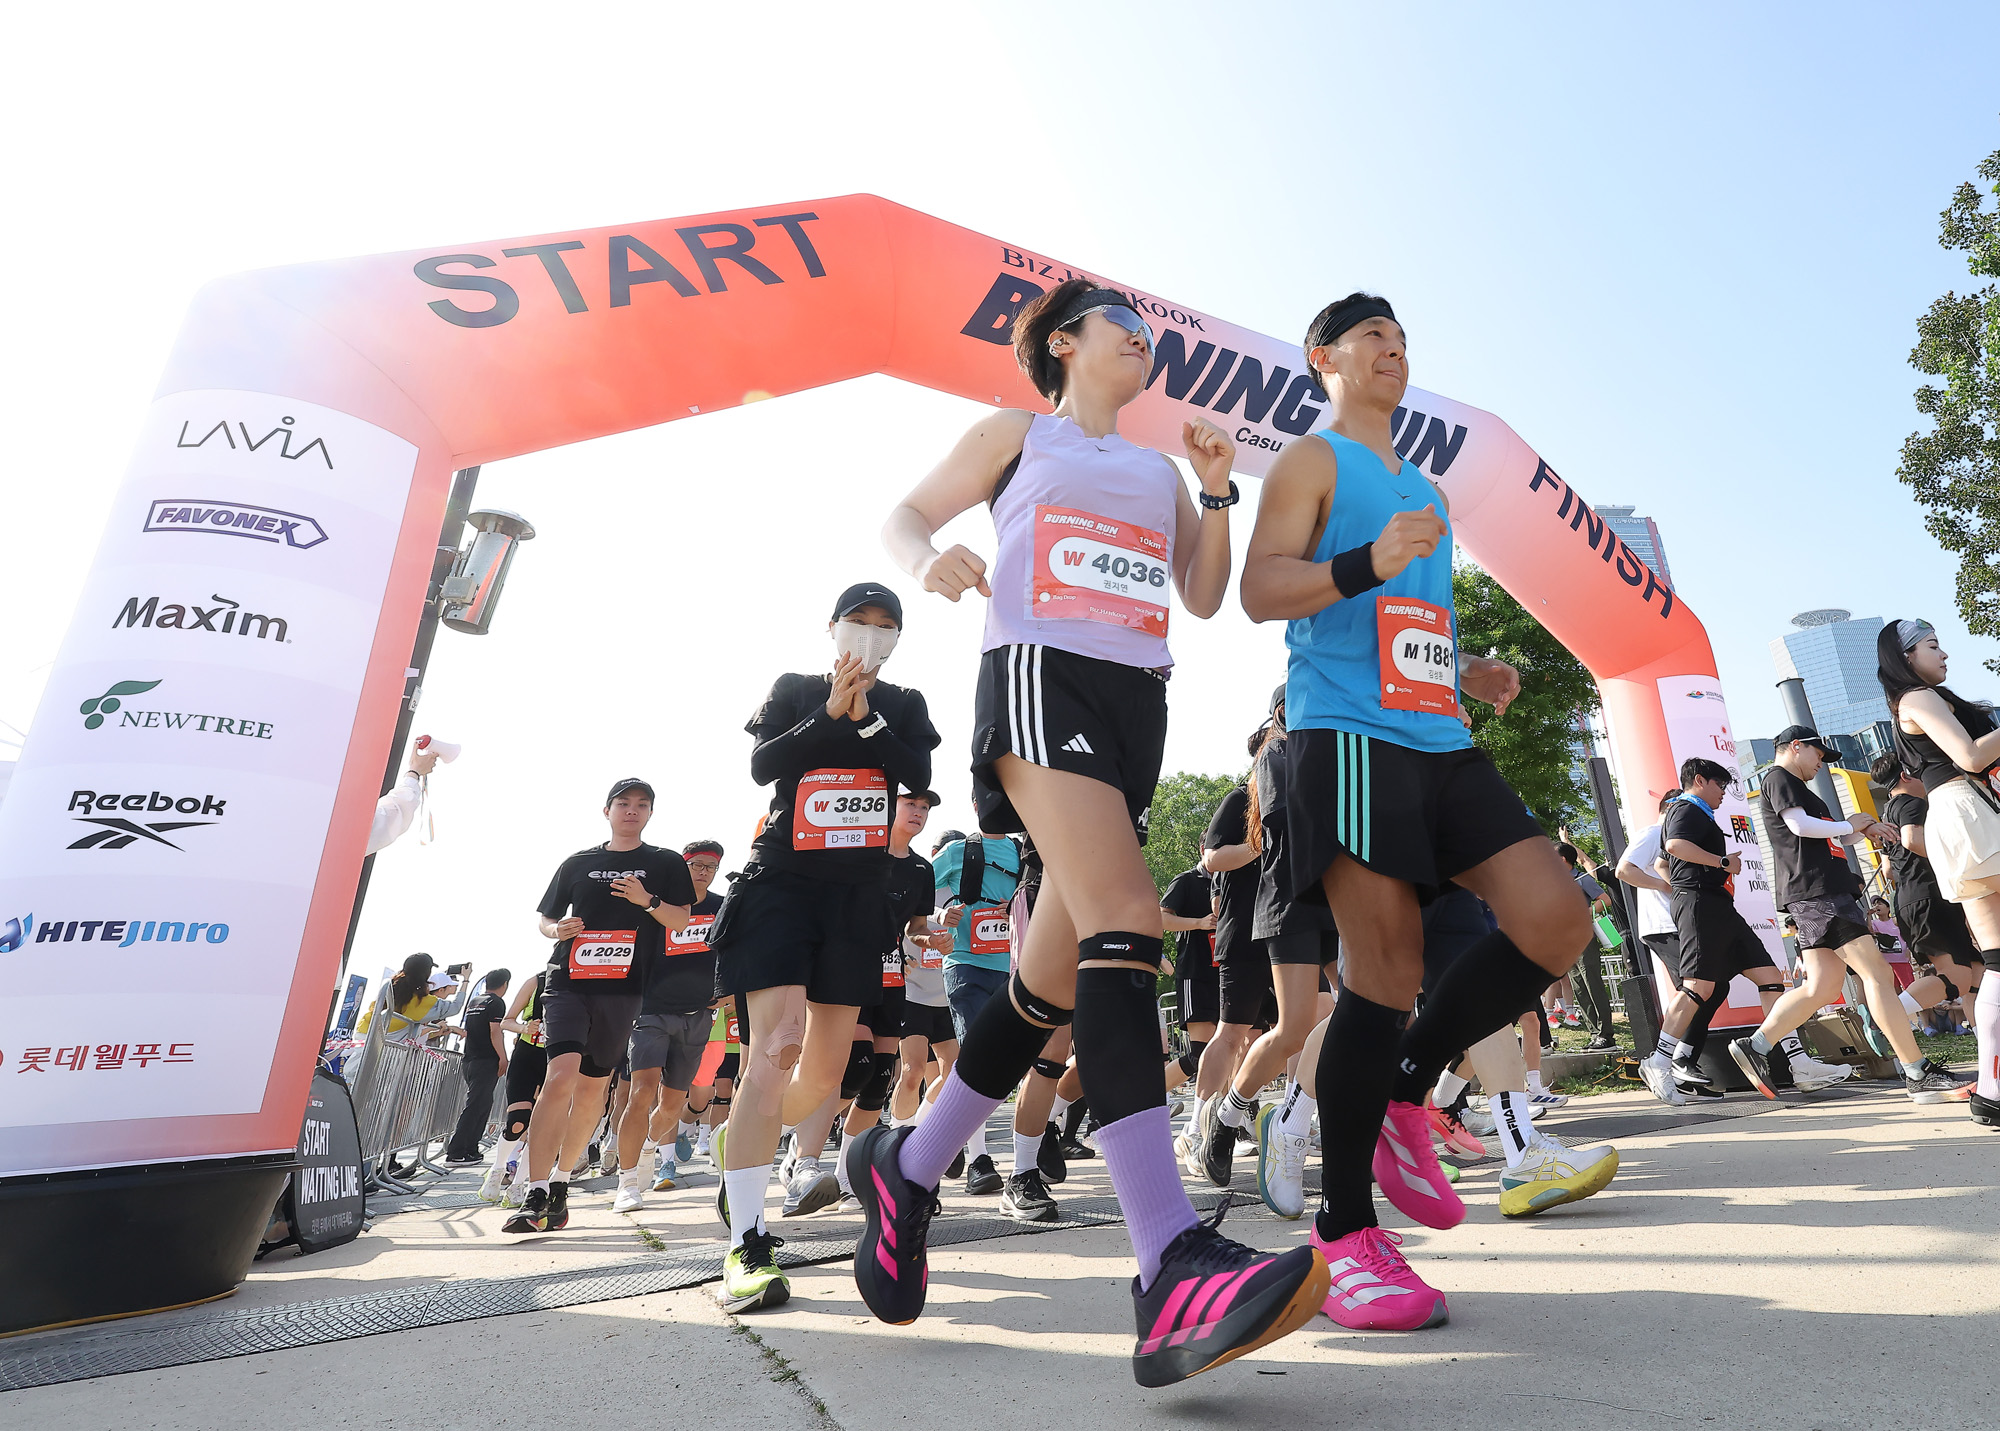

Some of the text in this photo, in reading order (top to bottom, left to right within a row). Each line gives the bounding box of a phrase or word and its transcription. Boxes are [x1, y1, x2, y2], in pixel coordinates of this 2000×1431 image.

[413, 212, 827, 328] START
[960, 272, 1468, 476] BNING UN
[155, 507, 302, 541] FAVONEX
[1043, 513, 1119, 535] BURNING RUN
[1139, 536, 1162, 550] 10km
[1529, 456, 1673, 619] FINISH
[1063, 550, 1085, 566] W
[1091, 553, 1165, 588] 4036
[112, 594, 289, 642] Maxim
[1383, 604, 1425, 618] BURNING
[1404, 642, 1454, 670] M 1881
[119, 711, 274, 740] NEWTREE
[837, 774, 856, 782] RUN
[67, 790, 227, 816] Reebok
[814, 796, 886, 813] W 3836
[831, 833, 862, 844] D-182
[588, 869, 647, 880] EIDER
[1748, 880, 1769, 892] JOURS
[981, 925, 989, 933] M
[581, 946, 632, 957] M 2029
[17, 1042, 195, 1074] 롯데웰푸드
[1503, 1108, 1519, 1131] FILA
[303, 1118, 331, 1157] START
[301, 1165, 359, 1205] WAITING LINE
